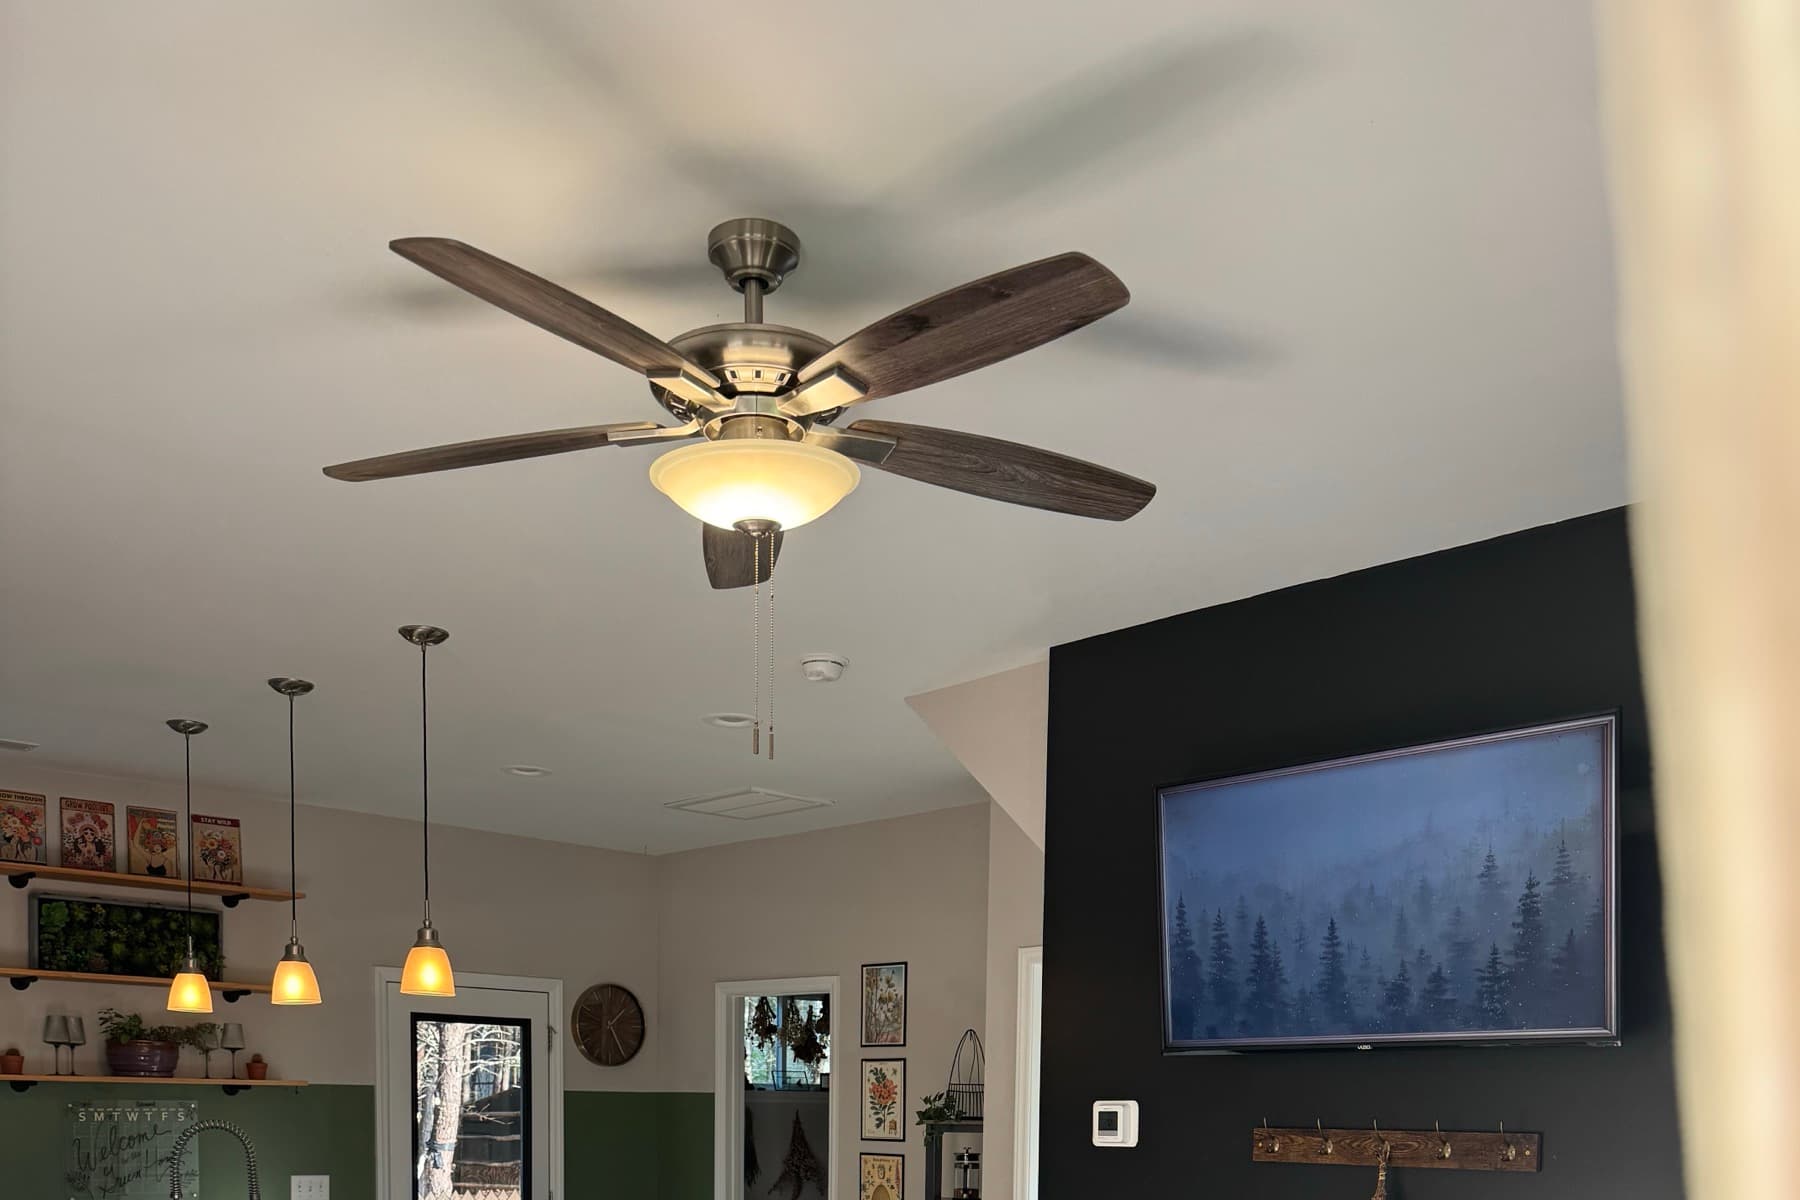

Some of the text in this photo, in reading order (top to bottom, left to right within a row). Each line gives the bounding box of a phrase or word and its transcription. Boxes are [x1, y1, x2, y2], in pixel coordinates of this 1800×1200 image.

[78, 1112, 185, 1122] S M T W T F S
[72, 1123, 172, 1172] Welcome
